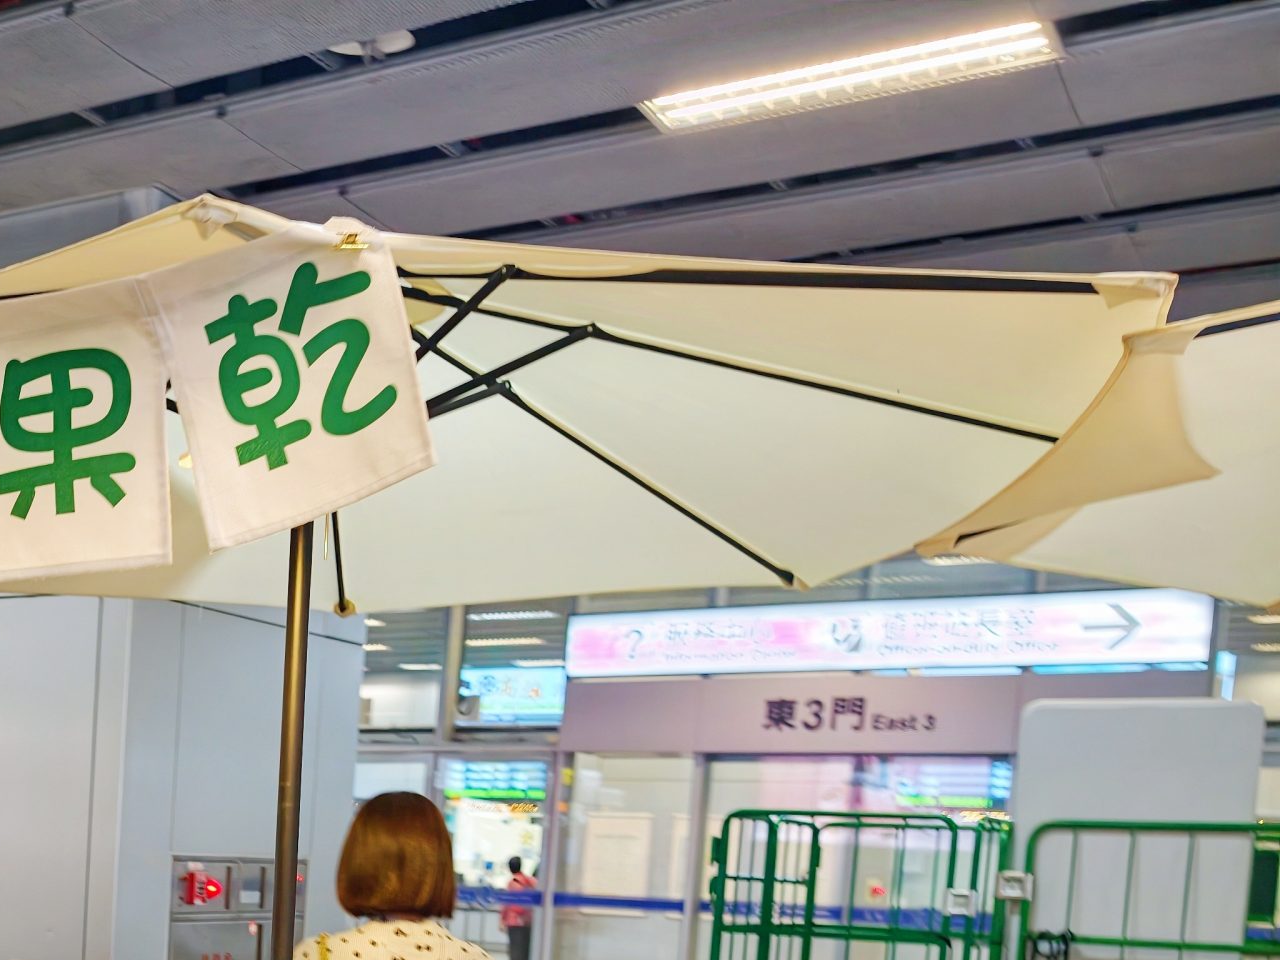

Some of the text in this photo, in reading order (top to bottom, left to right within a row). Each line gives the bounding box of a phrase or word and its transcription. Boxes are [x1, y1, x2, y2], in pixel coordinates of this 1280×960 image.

[762, 697, 936, 731] 東3門 East 3
